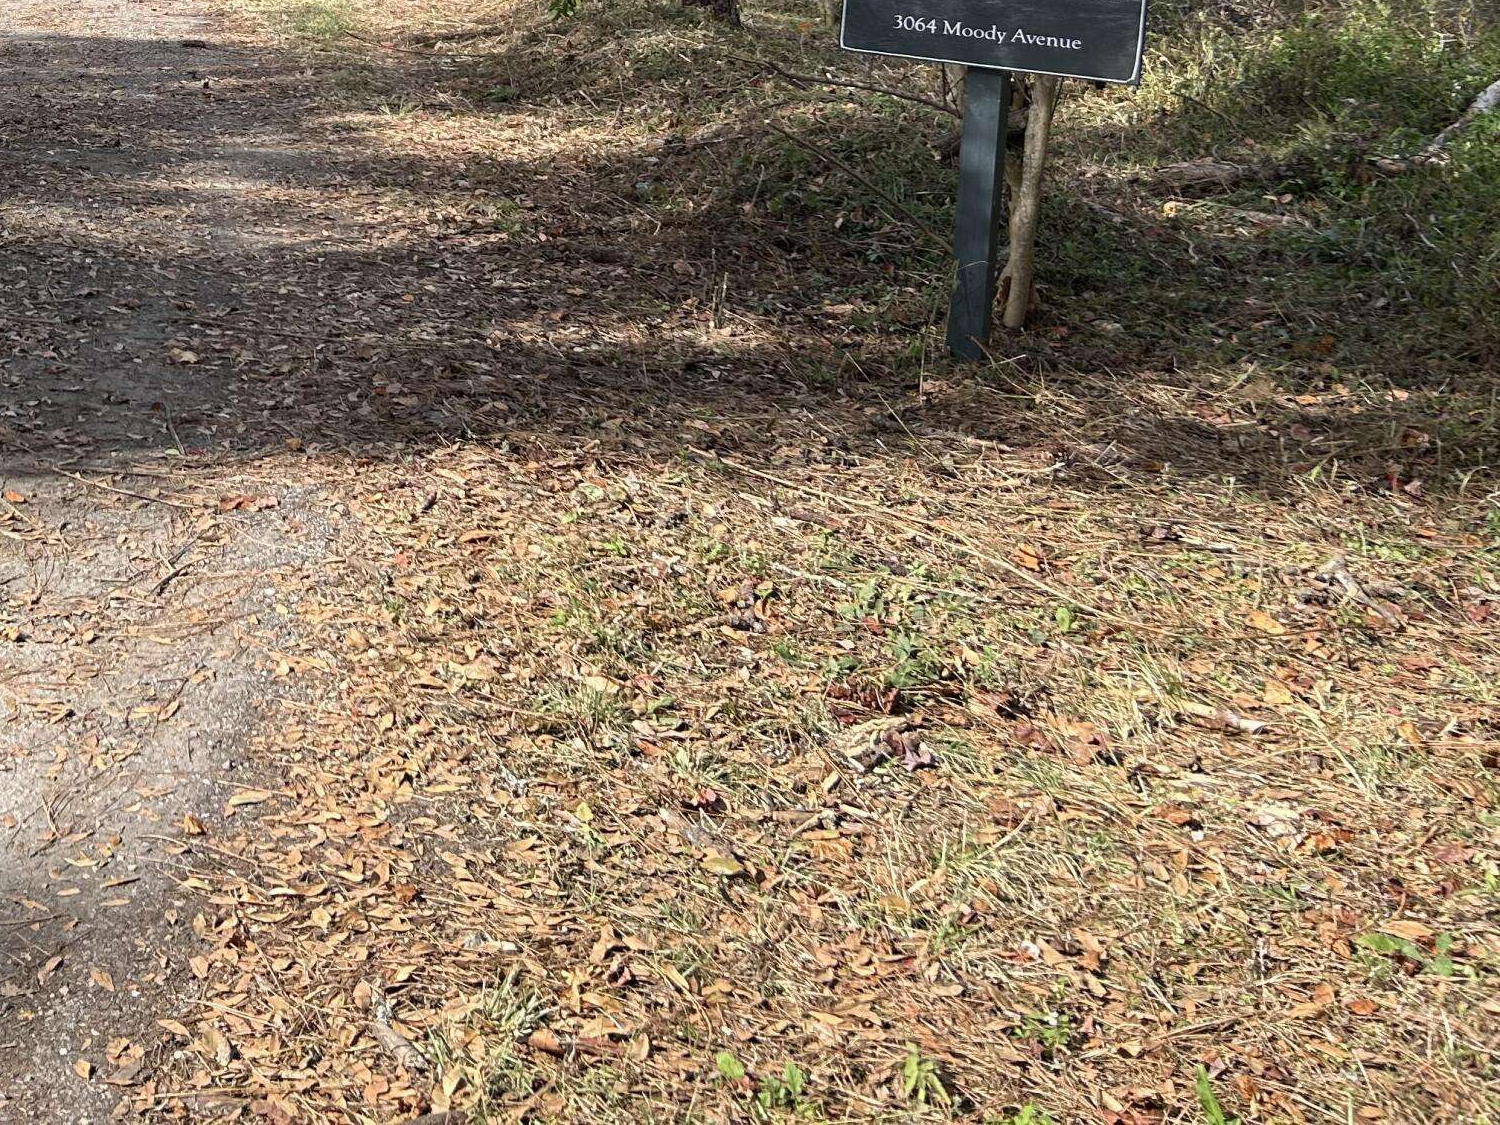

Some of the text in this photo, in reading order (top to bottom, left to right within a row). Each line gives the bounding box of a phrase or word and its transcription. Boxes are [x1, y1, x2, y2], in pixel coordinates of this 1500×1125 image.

[892, 14, 1082, 50] 3064 Moody Avenue
